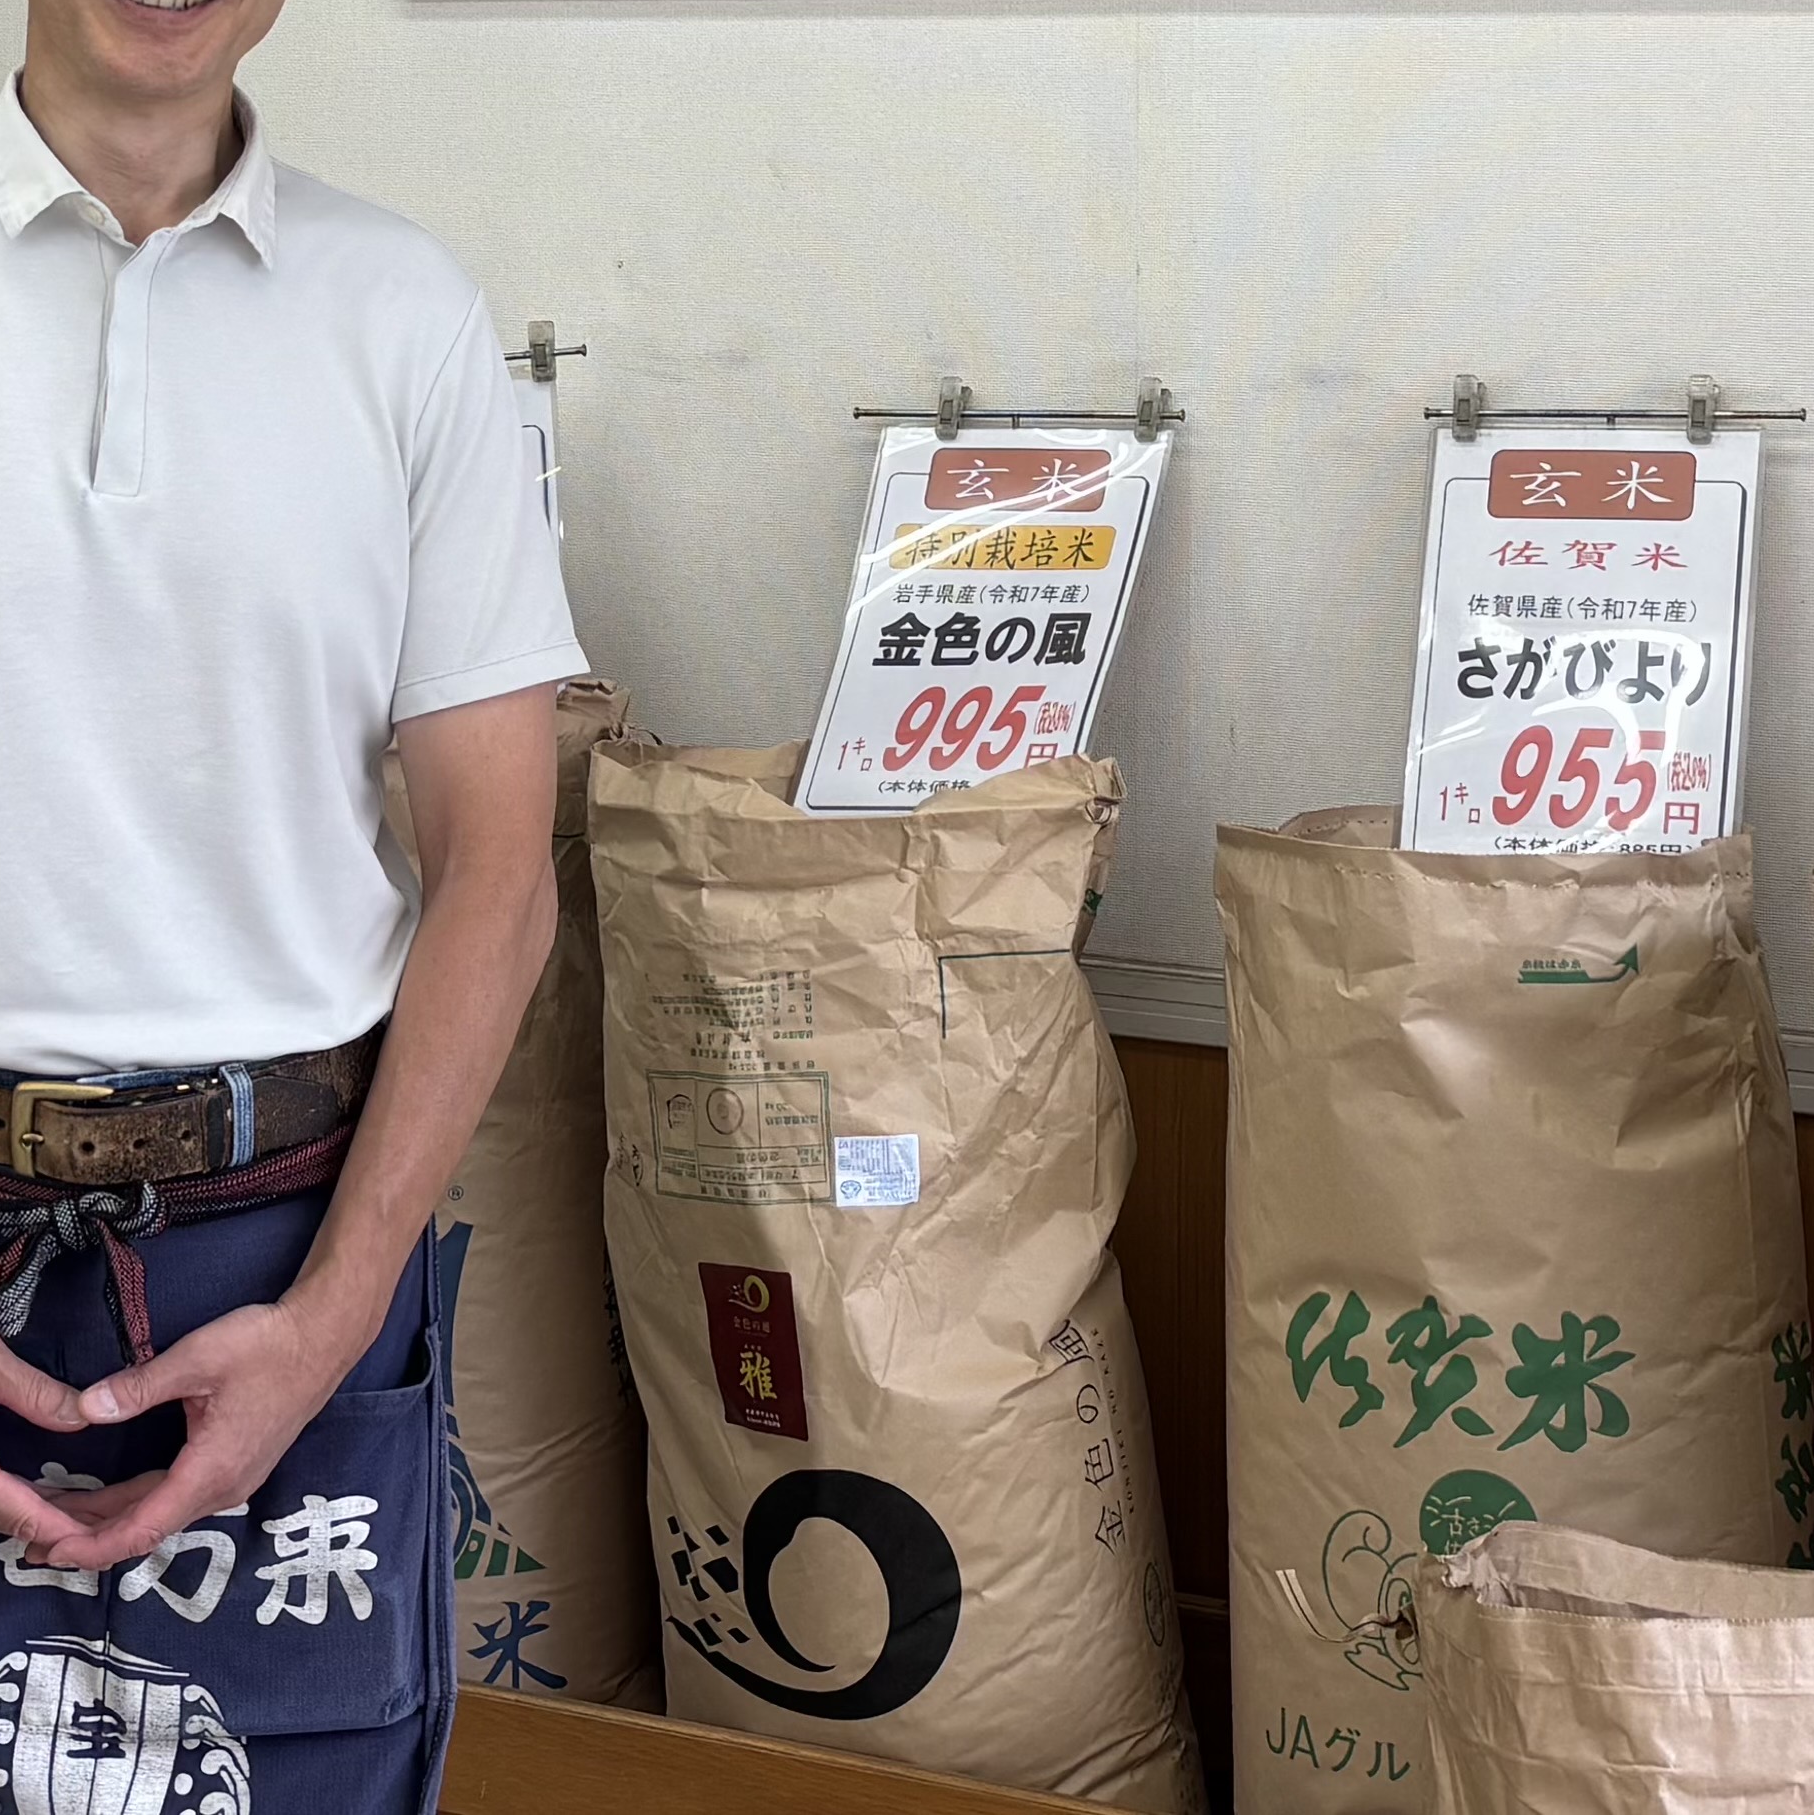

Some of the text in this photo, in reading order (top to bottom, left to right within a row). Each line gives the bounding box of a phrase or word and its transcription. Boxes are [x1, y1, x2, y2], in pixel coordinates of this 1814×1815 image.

[945, 458, 1085, 503] 玄米
[1509, 461, 1675, 511] 玄米
[1488, 539, 1689, 572] 佐賀米
[892, 583, 1091, 605] 岩手県産（令和7年産）
[1466, 593, 1698, 624] 佐賀県産（令和7年産）
[871, 610, 1092, 667] 金色の風
[1456, 634, 1713, 707] さがびより
[882, 685, 1047, 772] 995
[1024, 742, 1059, 768] 円
[1491, 724, 1667, 832] 955
[1662, 801, 1700, 835] 円
[739, 1350, 778, 1401] 雅
[1284, 1289, 1637, 1453] 佐賀米
[467, 1600, 569, 1690] 米
